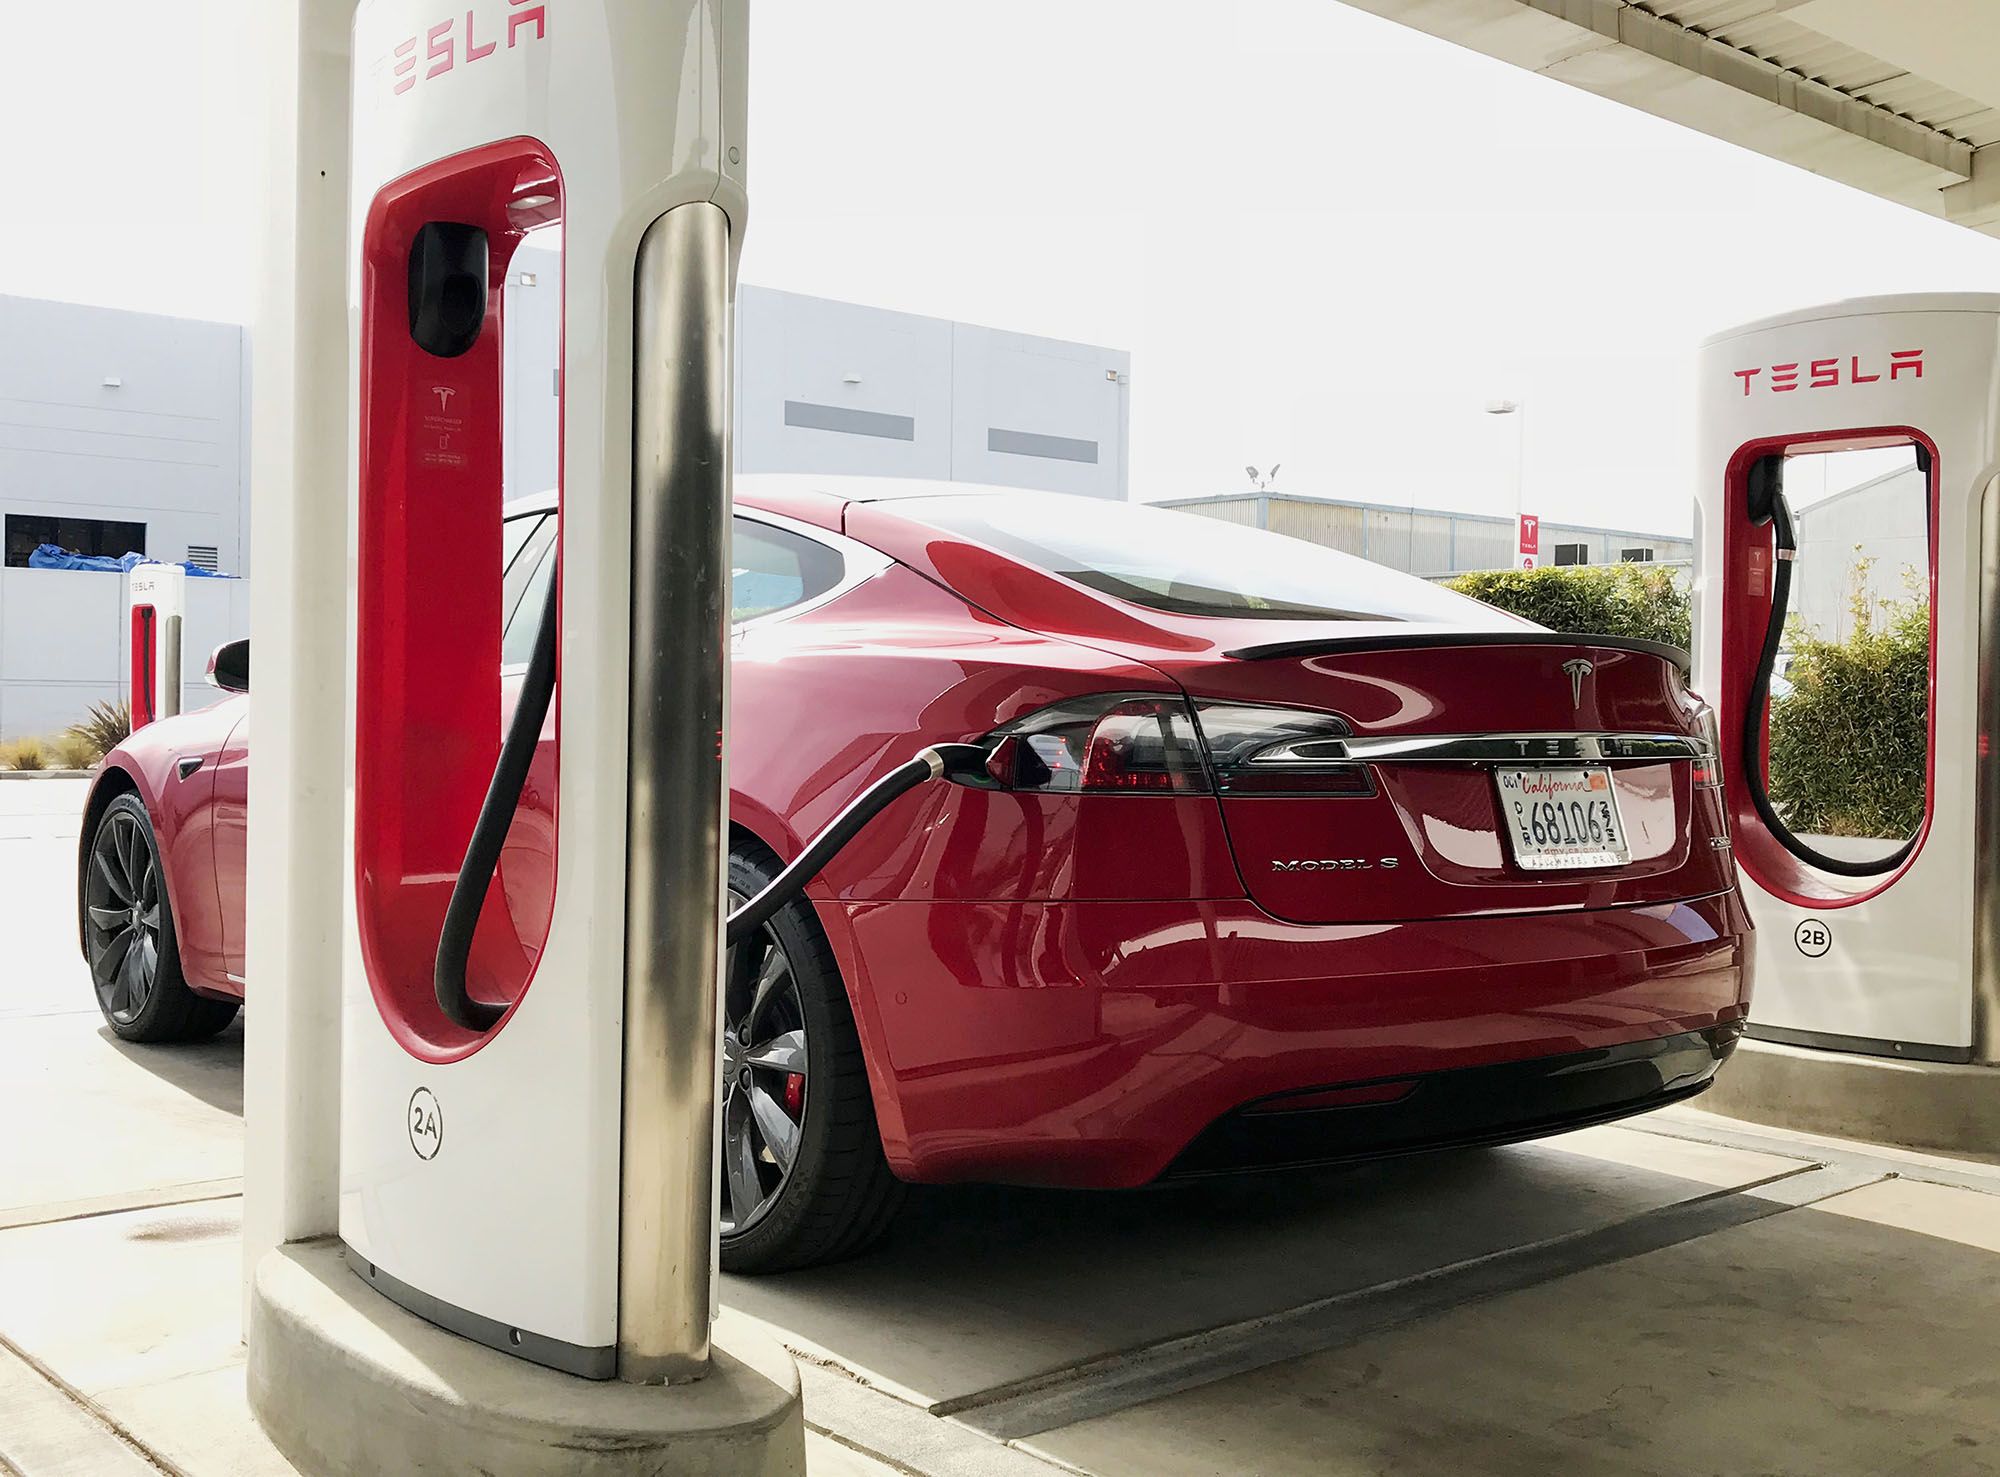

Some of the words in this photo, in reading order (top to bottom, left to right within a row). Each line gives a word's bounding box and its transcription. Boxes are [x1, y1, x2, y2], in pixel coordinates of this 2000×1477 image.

[393, 0, 545, 96] ESLA
[1734, 350, 1924, 397] TESLA
[1522, 773, 1593, 800] California
[1532, 801, 1602, 845] 68106
[1272, 859, 1373, 871] MODEL
[1380, 857, 1399, 869] S
[1801, 929, 1825, 945] 2B
[414, 1106, 437, 1140] 2A
